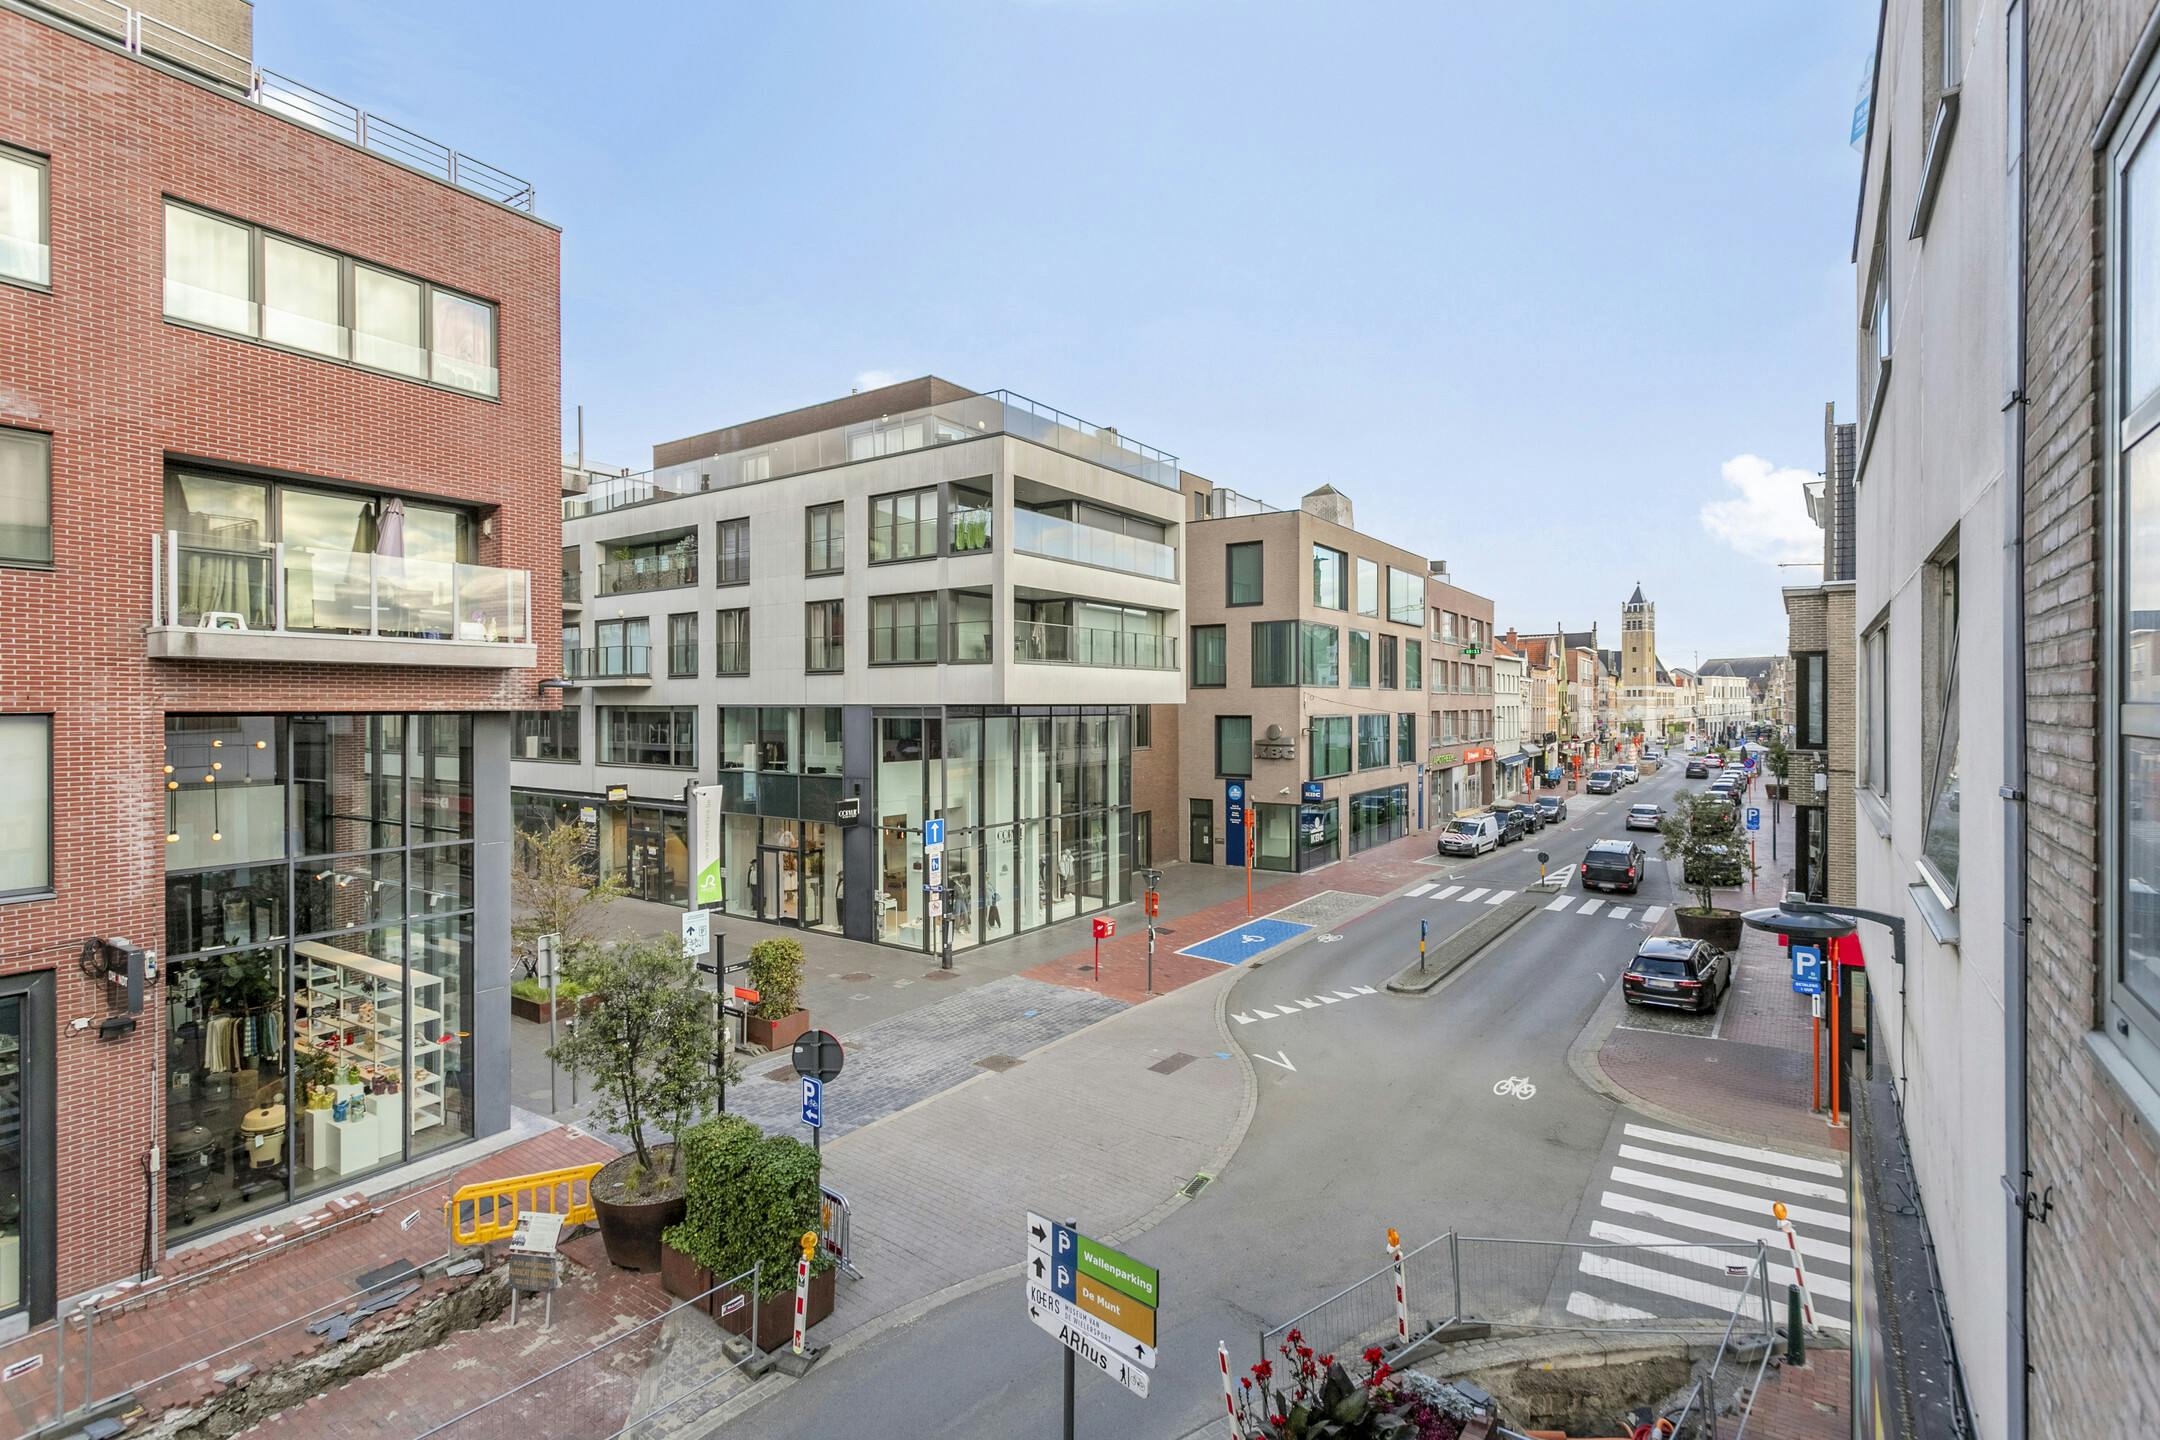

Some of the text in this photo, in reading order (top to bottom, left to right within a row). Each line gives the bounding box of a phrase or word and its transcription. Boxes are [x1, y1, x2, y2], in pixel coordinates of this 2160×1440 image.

[1748, 809, 1758, 821] P
[1310, 831, 1324, 844] KBC
[1796, 952, 1816, 975] P
[803, 1080, 815, 1106] P
[1058, 1234, 1153, 1293] P Wallenparking
[1031, 1286, 1060, 1315] KOERS
[1057, 1269, 1121, 1316] P De Munt
[1064, 1304, 1100, 1328] MUSEUM VAN
[1064, 1312, 1112, 1342] DE WIELERSPORT
[1059, 1325, 1108, 1370] ARhus
